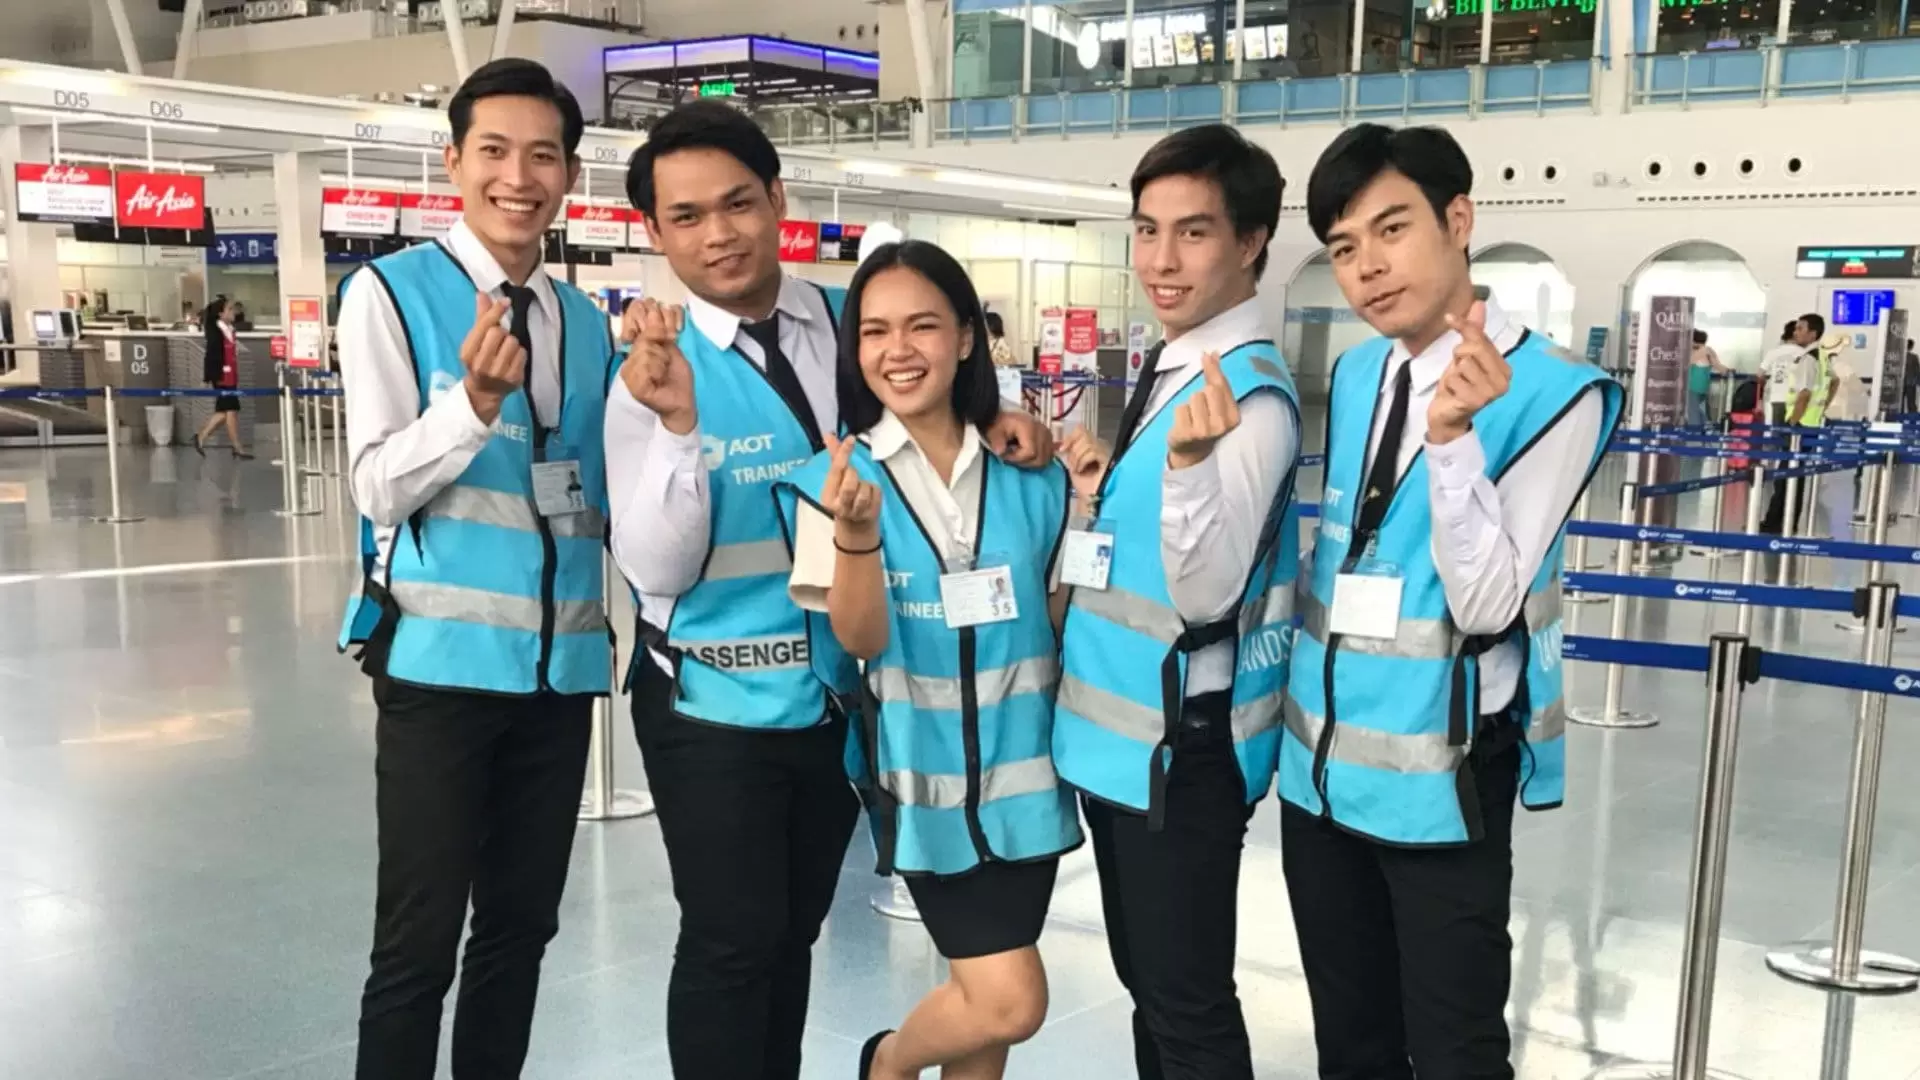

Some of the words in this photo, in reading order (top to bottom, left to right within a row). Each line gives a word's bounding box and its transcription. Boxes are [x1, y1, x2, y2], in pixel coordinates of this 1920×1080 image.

[54, 89, 90, 108] D05
[150, 100, 183, 118] D06
[355, 123, 382, 138] D07
[432, 131, 450, 145] D0
[595, 147, 618, 161] D09
[133, 343, 147, 361] D
[131, 361, 150, 375] 05
[728, 433, 776, 456] AOT
[688, 640, 809, 669] SSENGE
